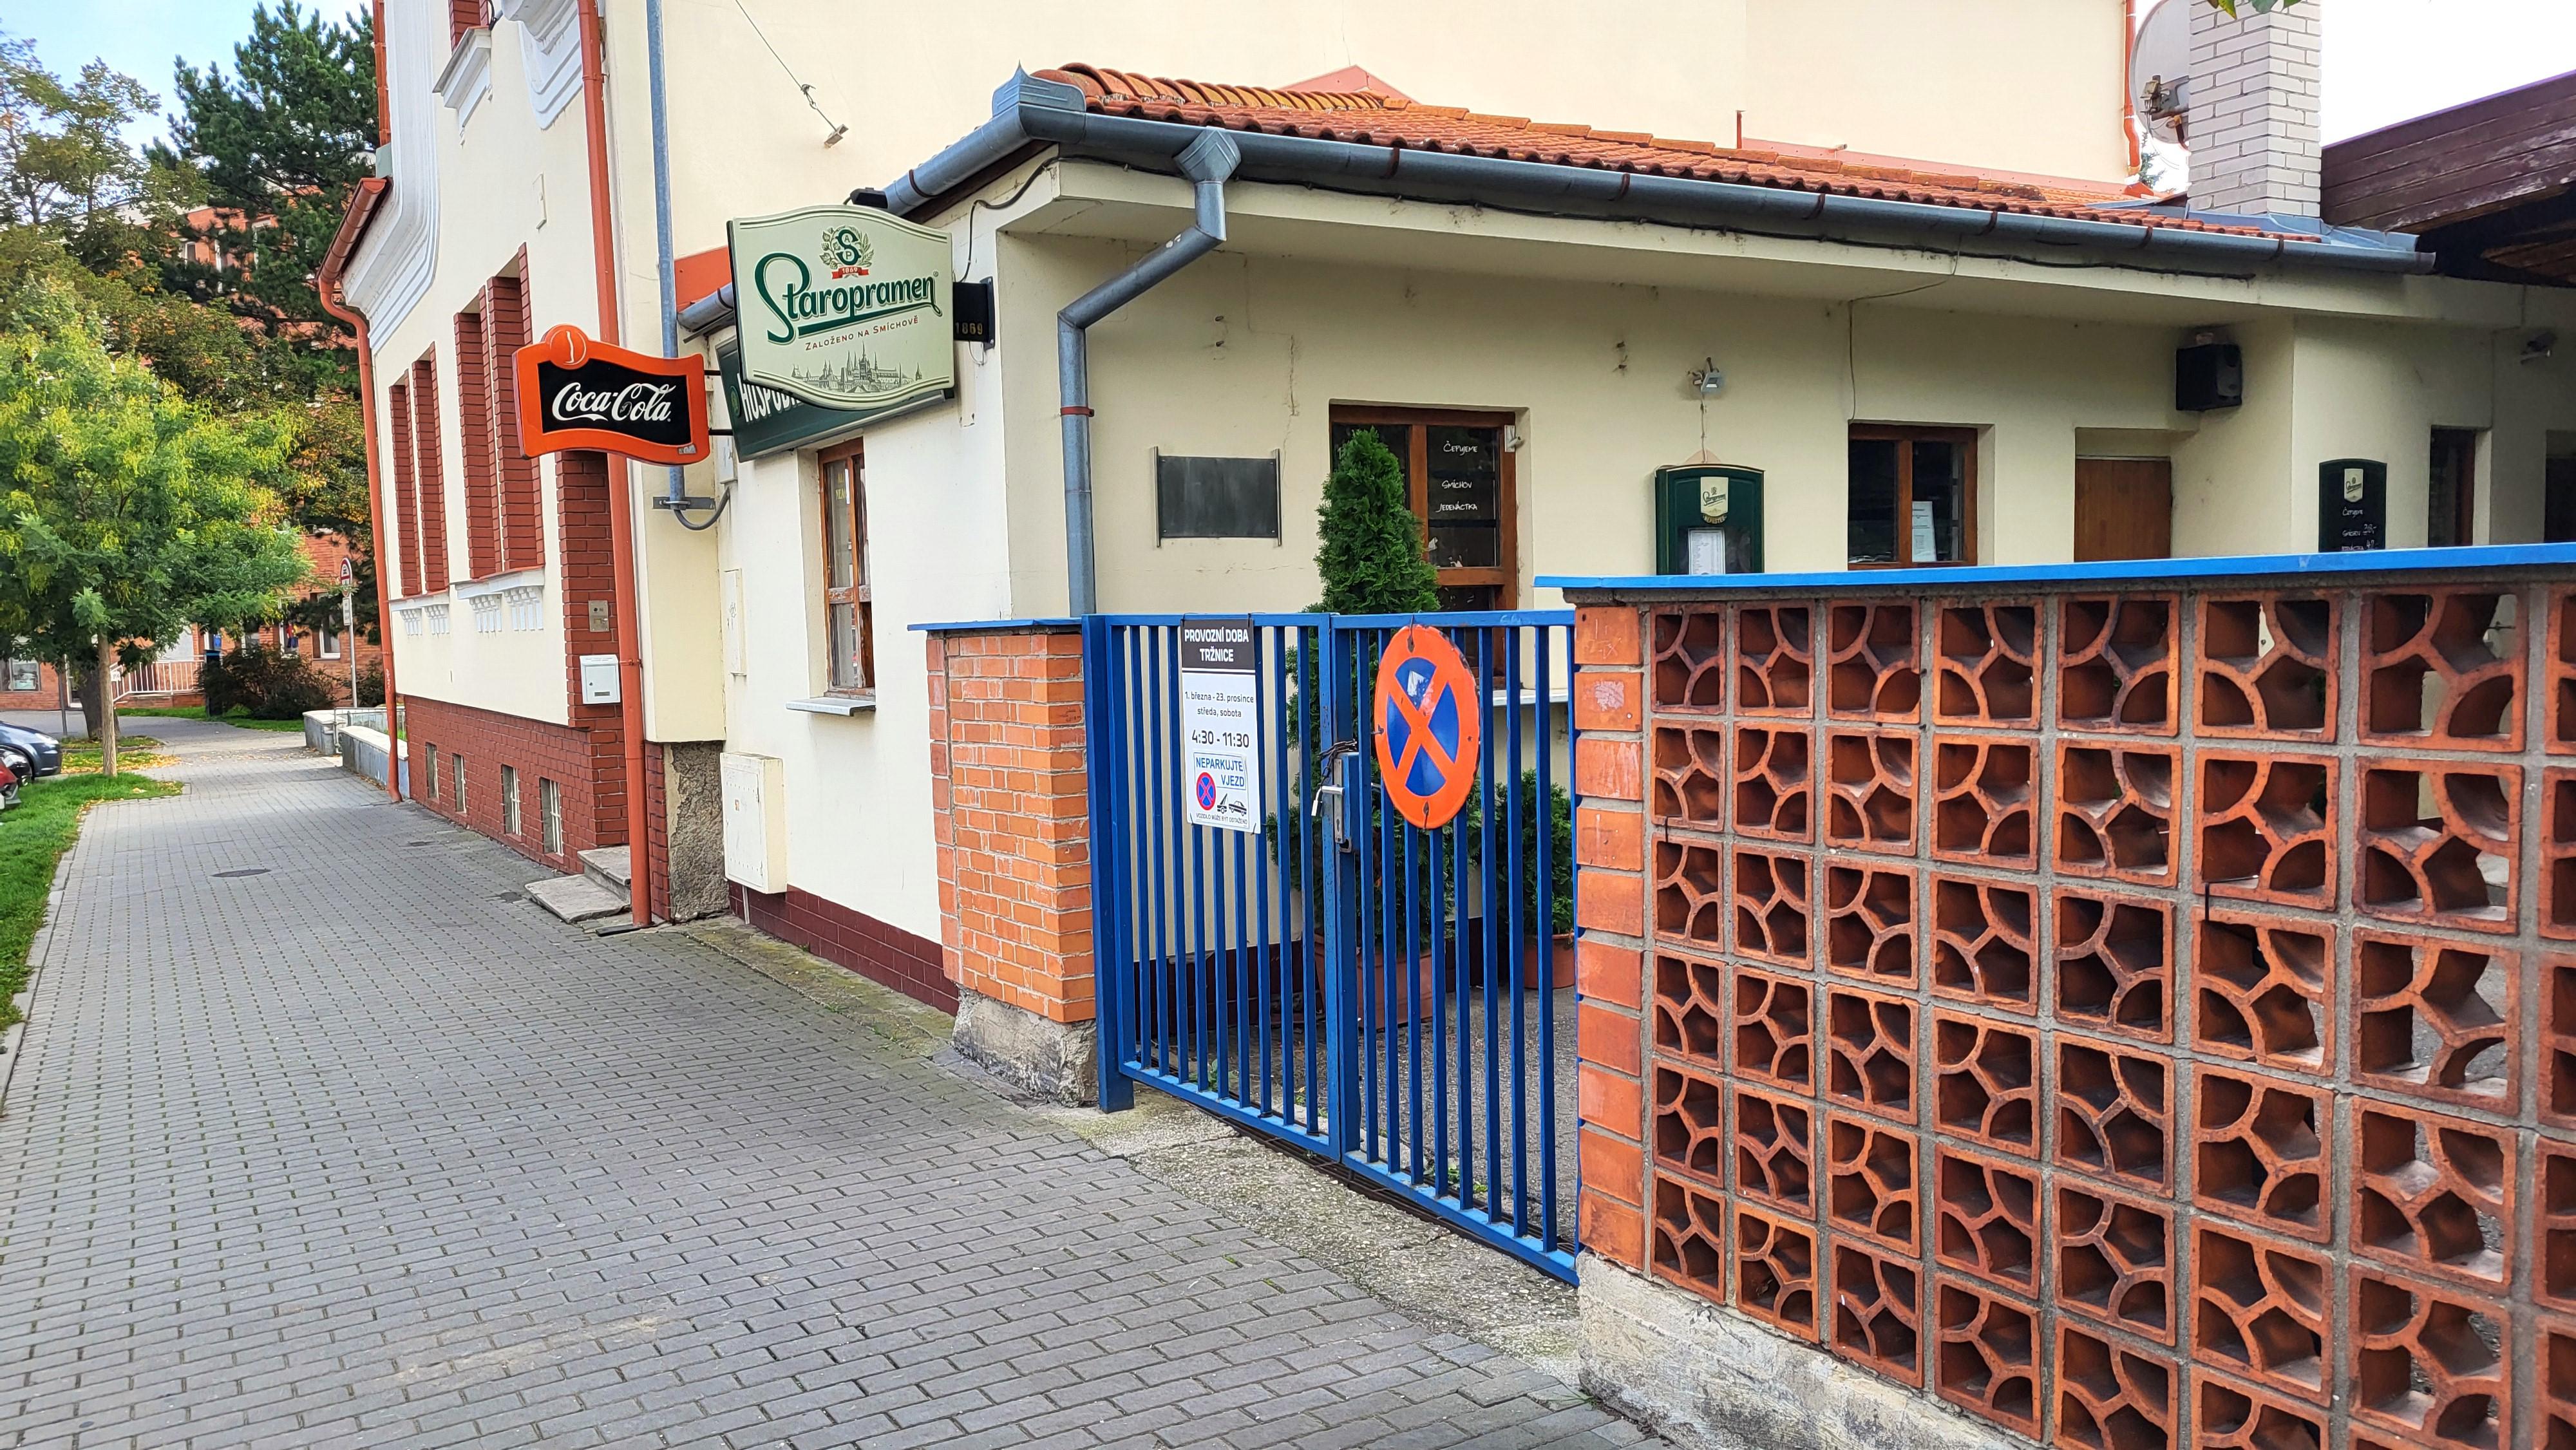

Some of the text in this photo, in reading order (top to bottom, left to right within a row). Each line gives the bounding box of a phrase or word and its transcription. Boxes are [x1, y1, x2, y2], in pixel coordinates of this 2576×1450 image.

[754, 252, 943, 343] Staropramen
[955, 322, 983, 335] 1869
[552, 382, 676, 422] Coca-Cola
[1184, 626, 1249, 643] PROVOZNÍ DOBA
[1199, 646, 1234, 662] TRŽNICE
[1191, 692, 1211, 701] března
[1216, 692, 1226, 701] 23.
[1227, 694, 1254, 703] prosince
[1197, 707, 1242, 717] středa, sobota
[1192, 730, 1214, 745] 4:30
[1222, 732, 1249, 748] 11:30
[1196, 757, 1244, 771] NEPARKUJTE
[1221, 775, 1244, 787] VJEZD
